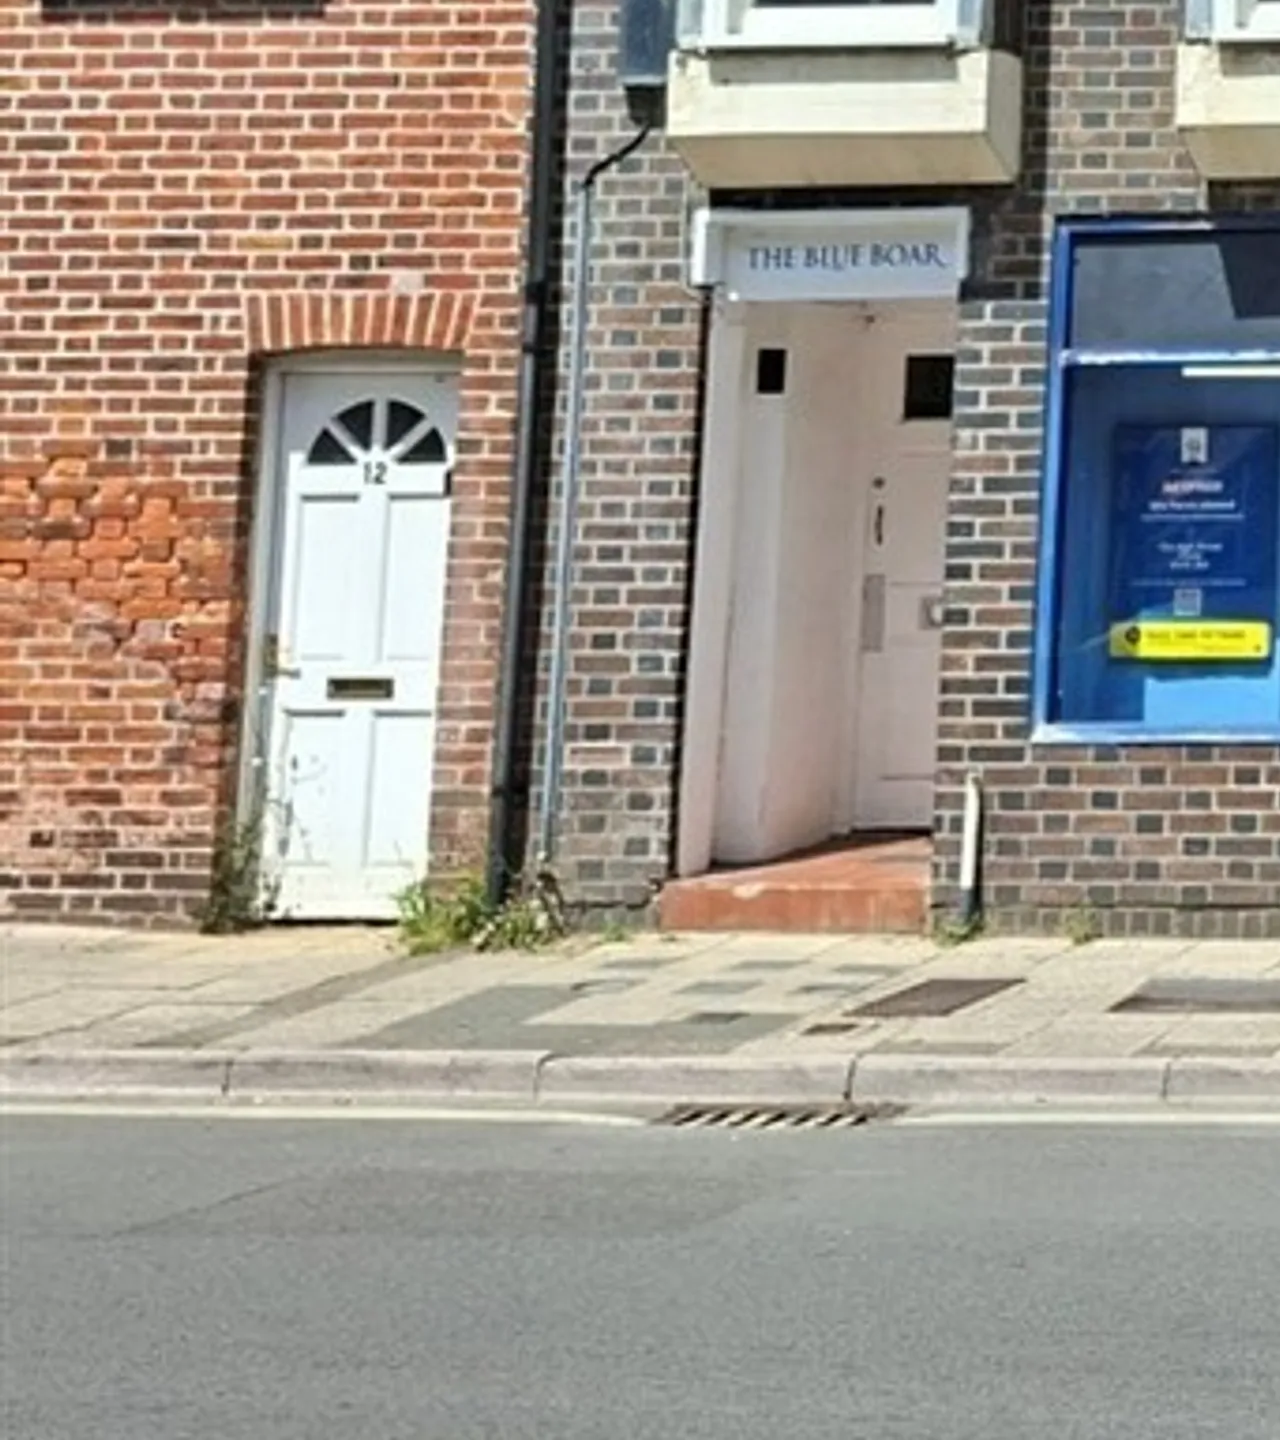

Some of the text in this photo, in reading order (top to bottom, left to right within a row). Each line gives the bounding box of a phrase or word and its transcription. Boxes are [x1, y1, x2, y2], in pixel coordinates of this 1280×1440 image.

[749, 246, 796, 271] THE
[869, 241, 949, 268] BOAR
[363, 460, 388, 485] 12
